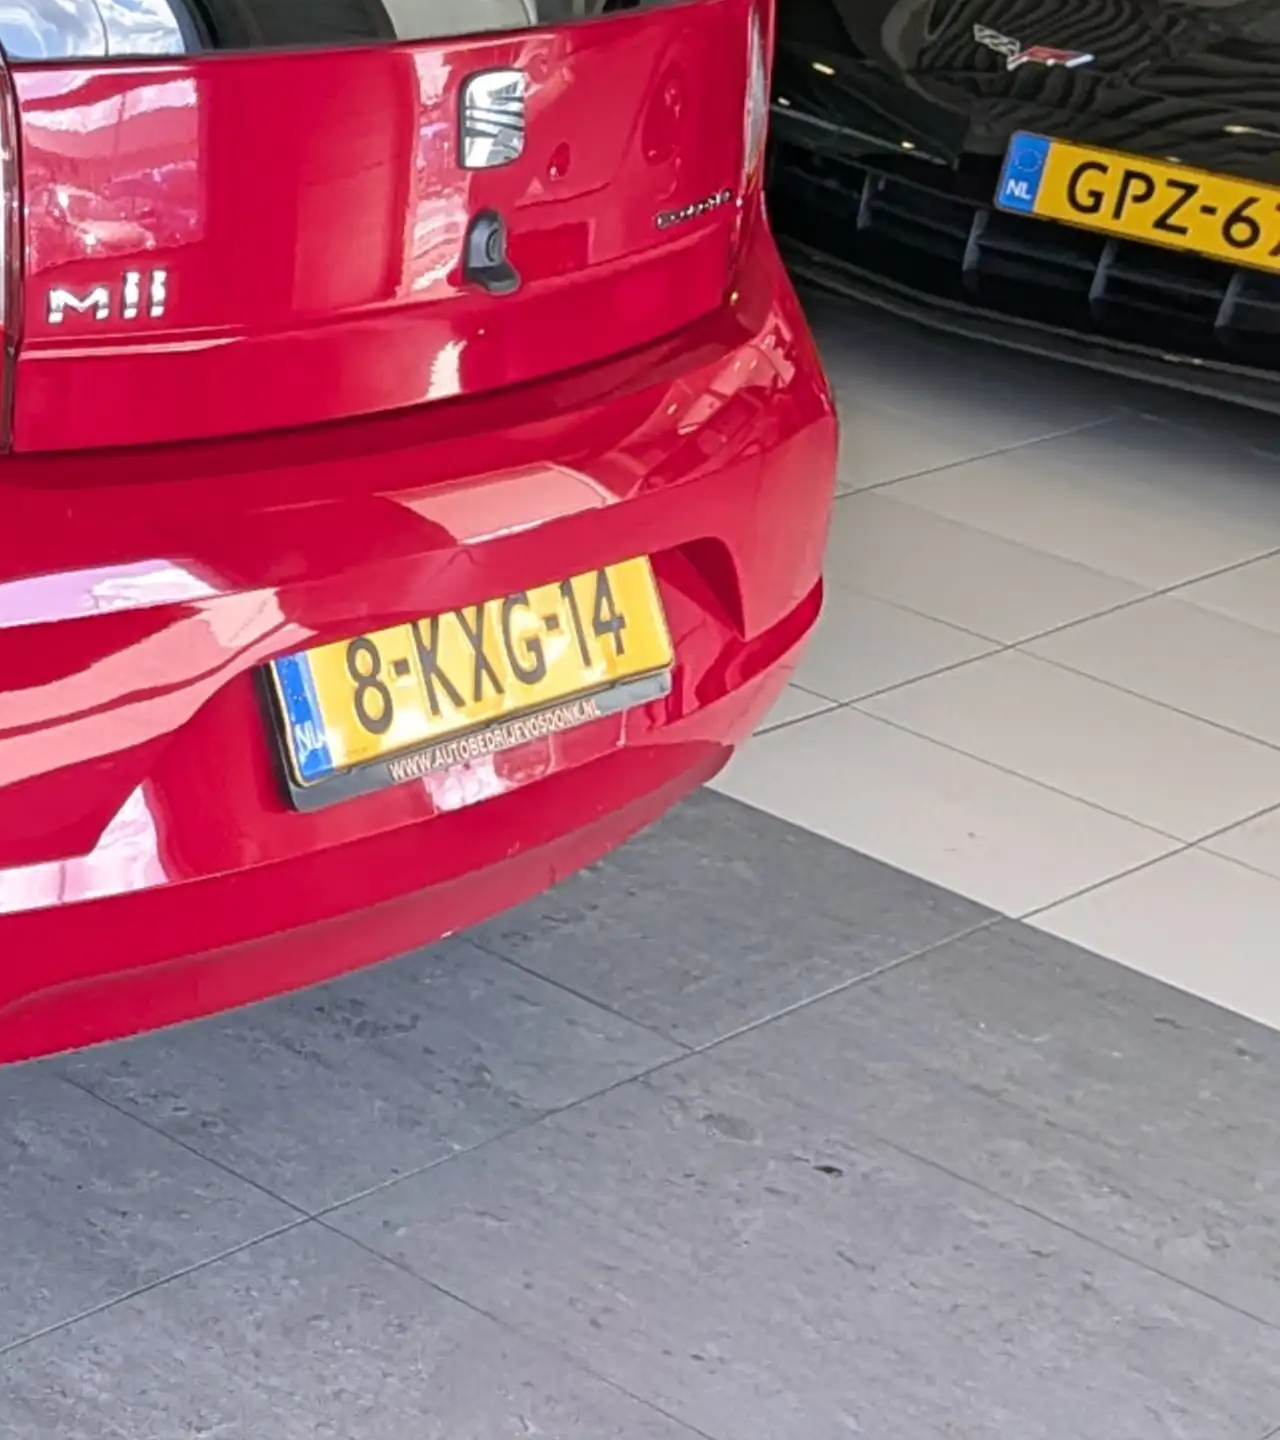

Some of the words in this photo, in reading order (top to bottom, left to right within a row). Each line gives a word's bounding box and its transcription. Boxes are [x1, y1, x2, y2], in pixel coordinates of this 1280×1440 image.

[1006, 178, 1032, 201] NL
[1065, 160, 1280, 257] GPZ-6
[47, 269, 168, 325] Mii
[345, 569, 627, 736] 8-KXG-14
[294, 721, 324, 757] NL
